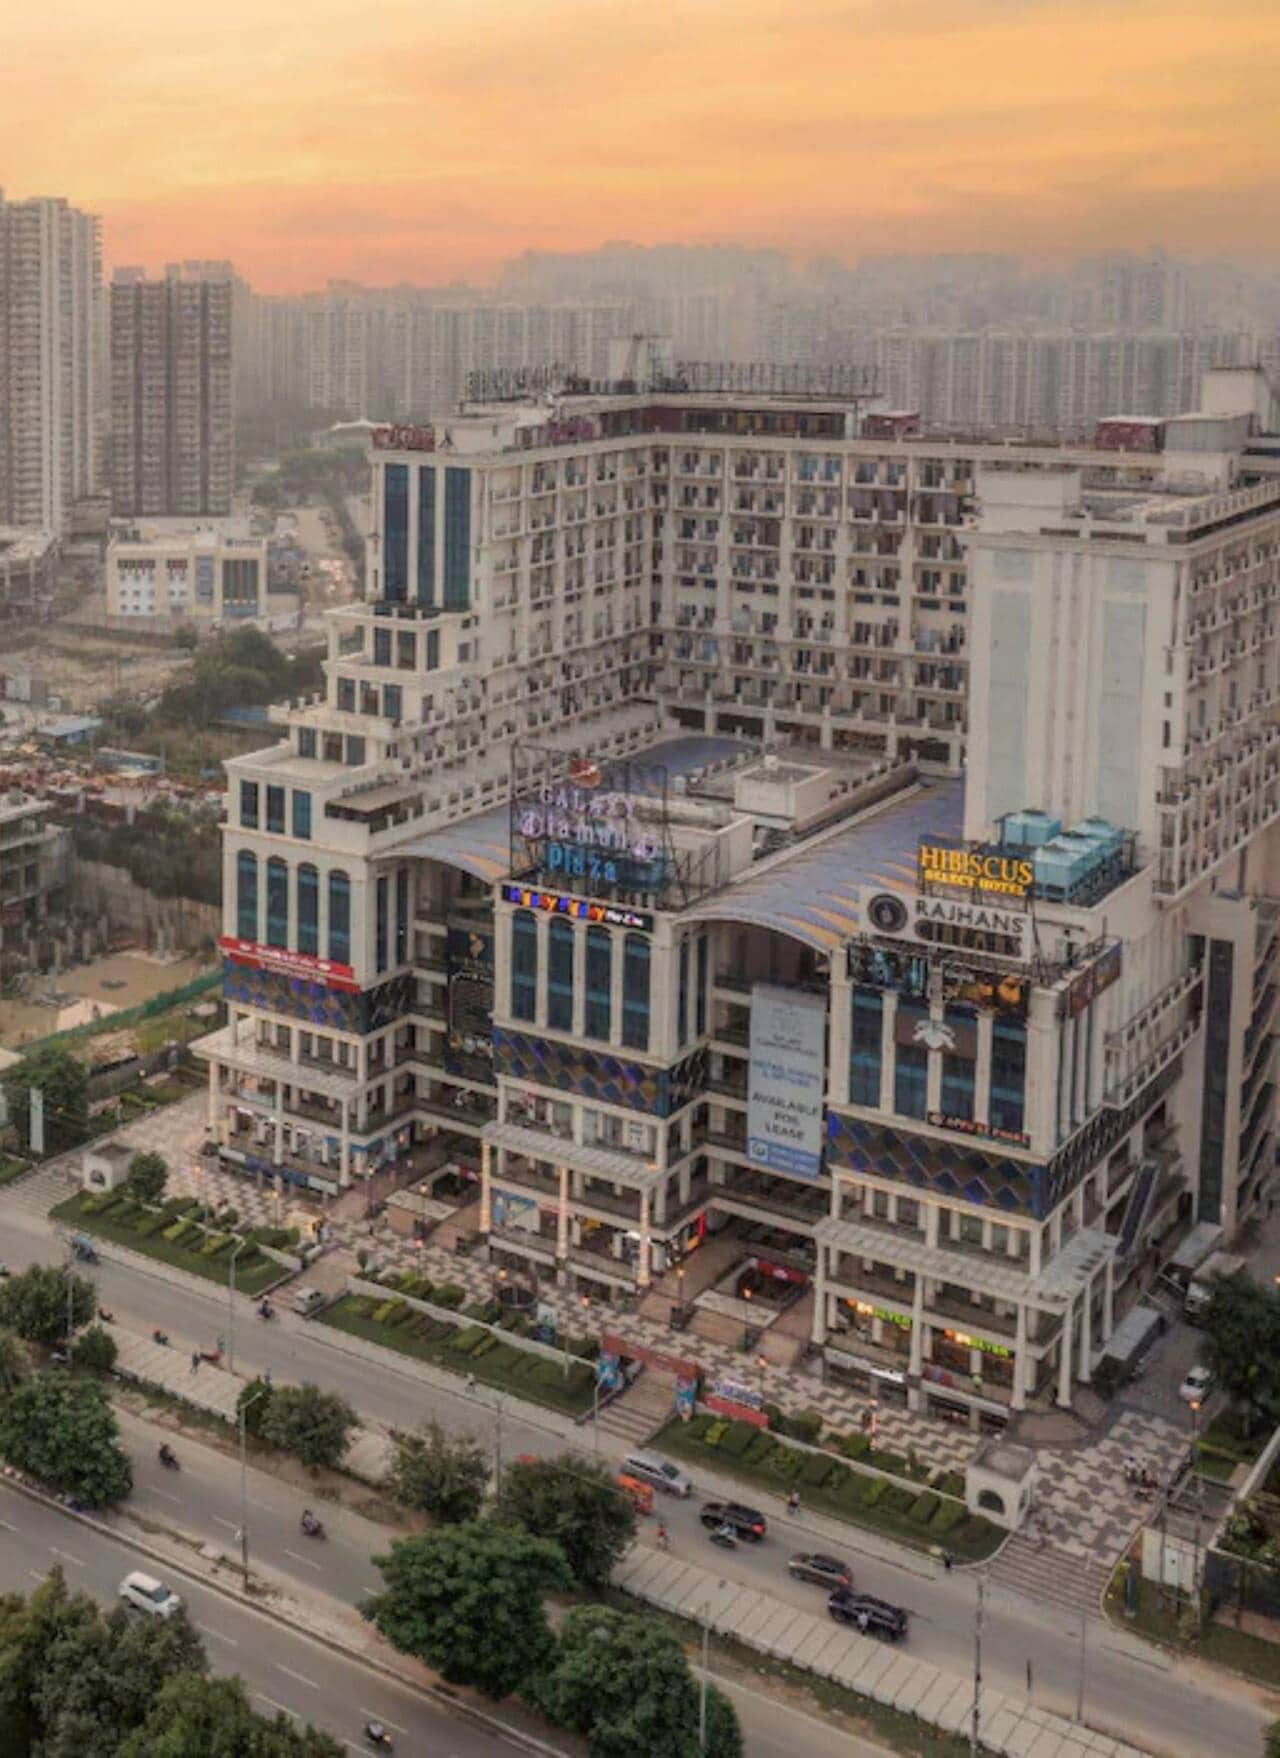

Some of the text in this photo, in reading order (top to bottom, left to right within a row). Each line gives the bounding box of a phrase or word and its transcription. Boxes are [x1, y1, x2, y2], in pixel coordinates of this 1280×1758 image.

[920, 845, 1033, 885] HIBISCUS
[978, 877, 1026, 897] HOTEL
[916, 899, 1024, 934] RAJHANS
